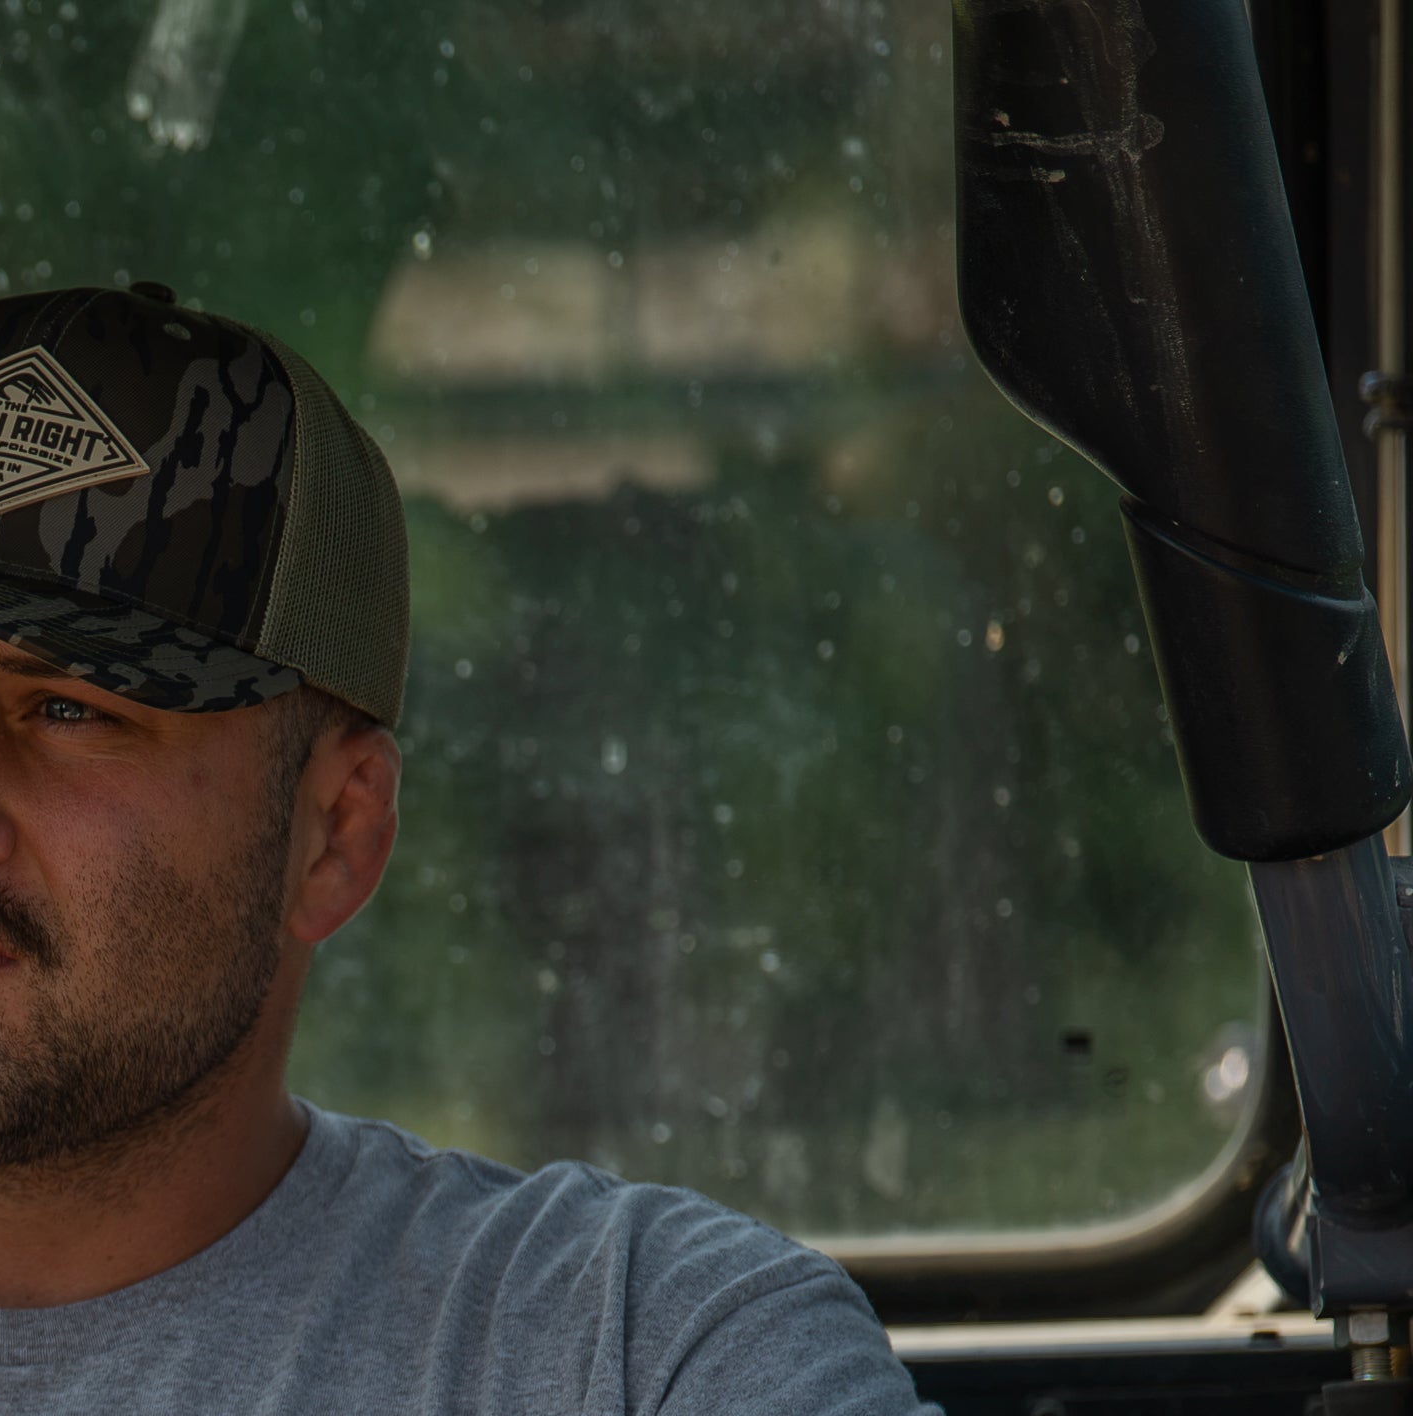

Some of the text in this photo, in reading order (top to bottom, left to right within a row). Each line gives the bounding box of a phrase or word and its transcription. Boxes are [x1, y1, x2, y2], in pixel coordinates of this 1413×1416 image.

[3, 401, 30, 413] THE
[10, 415, 105, 462] RIGHT
[7, 460, 22, 474] IN
